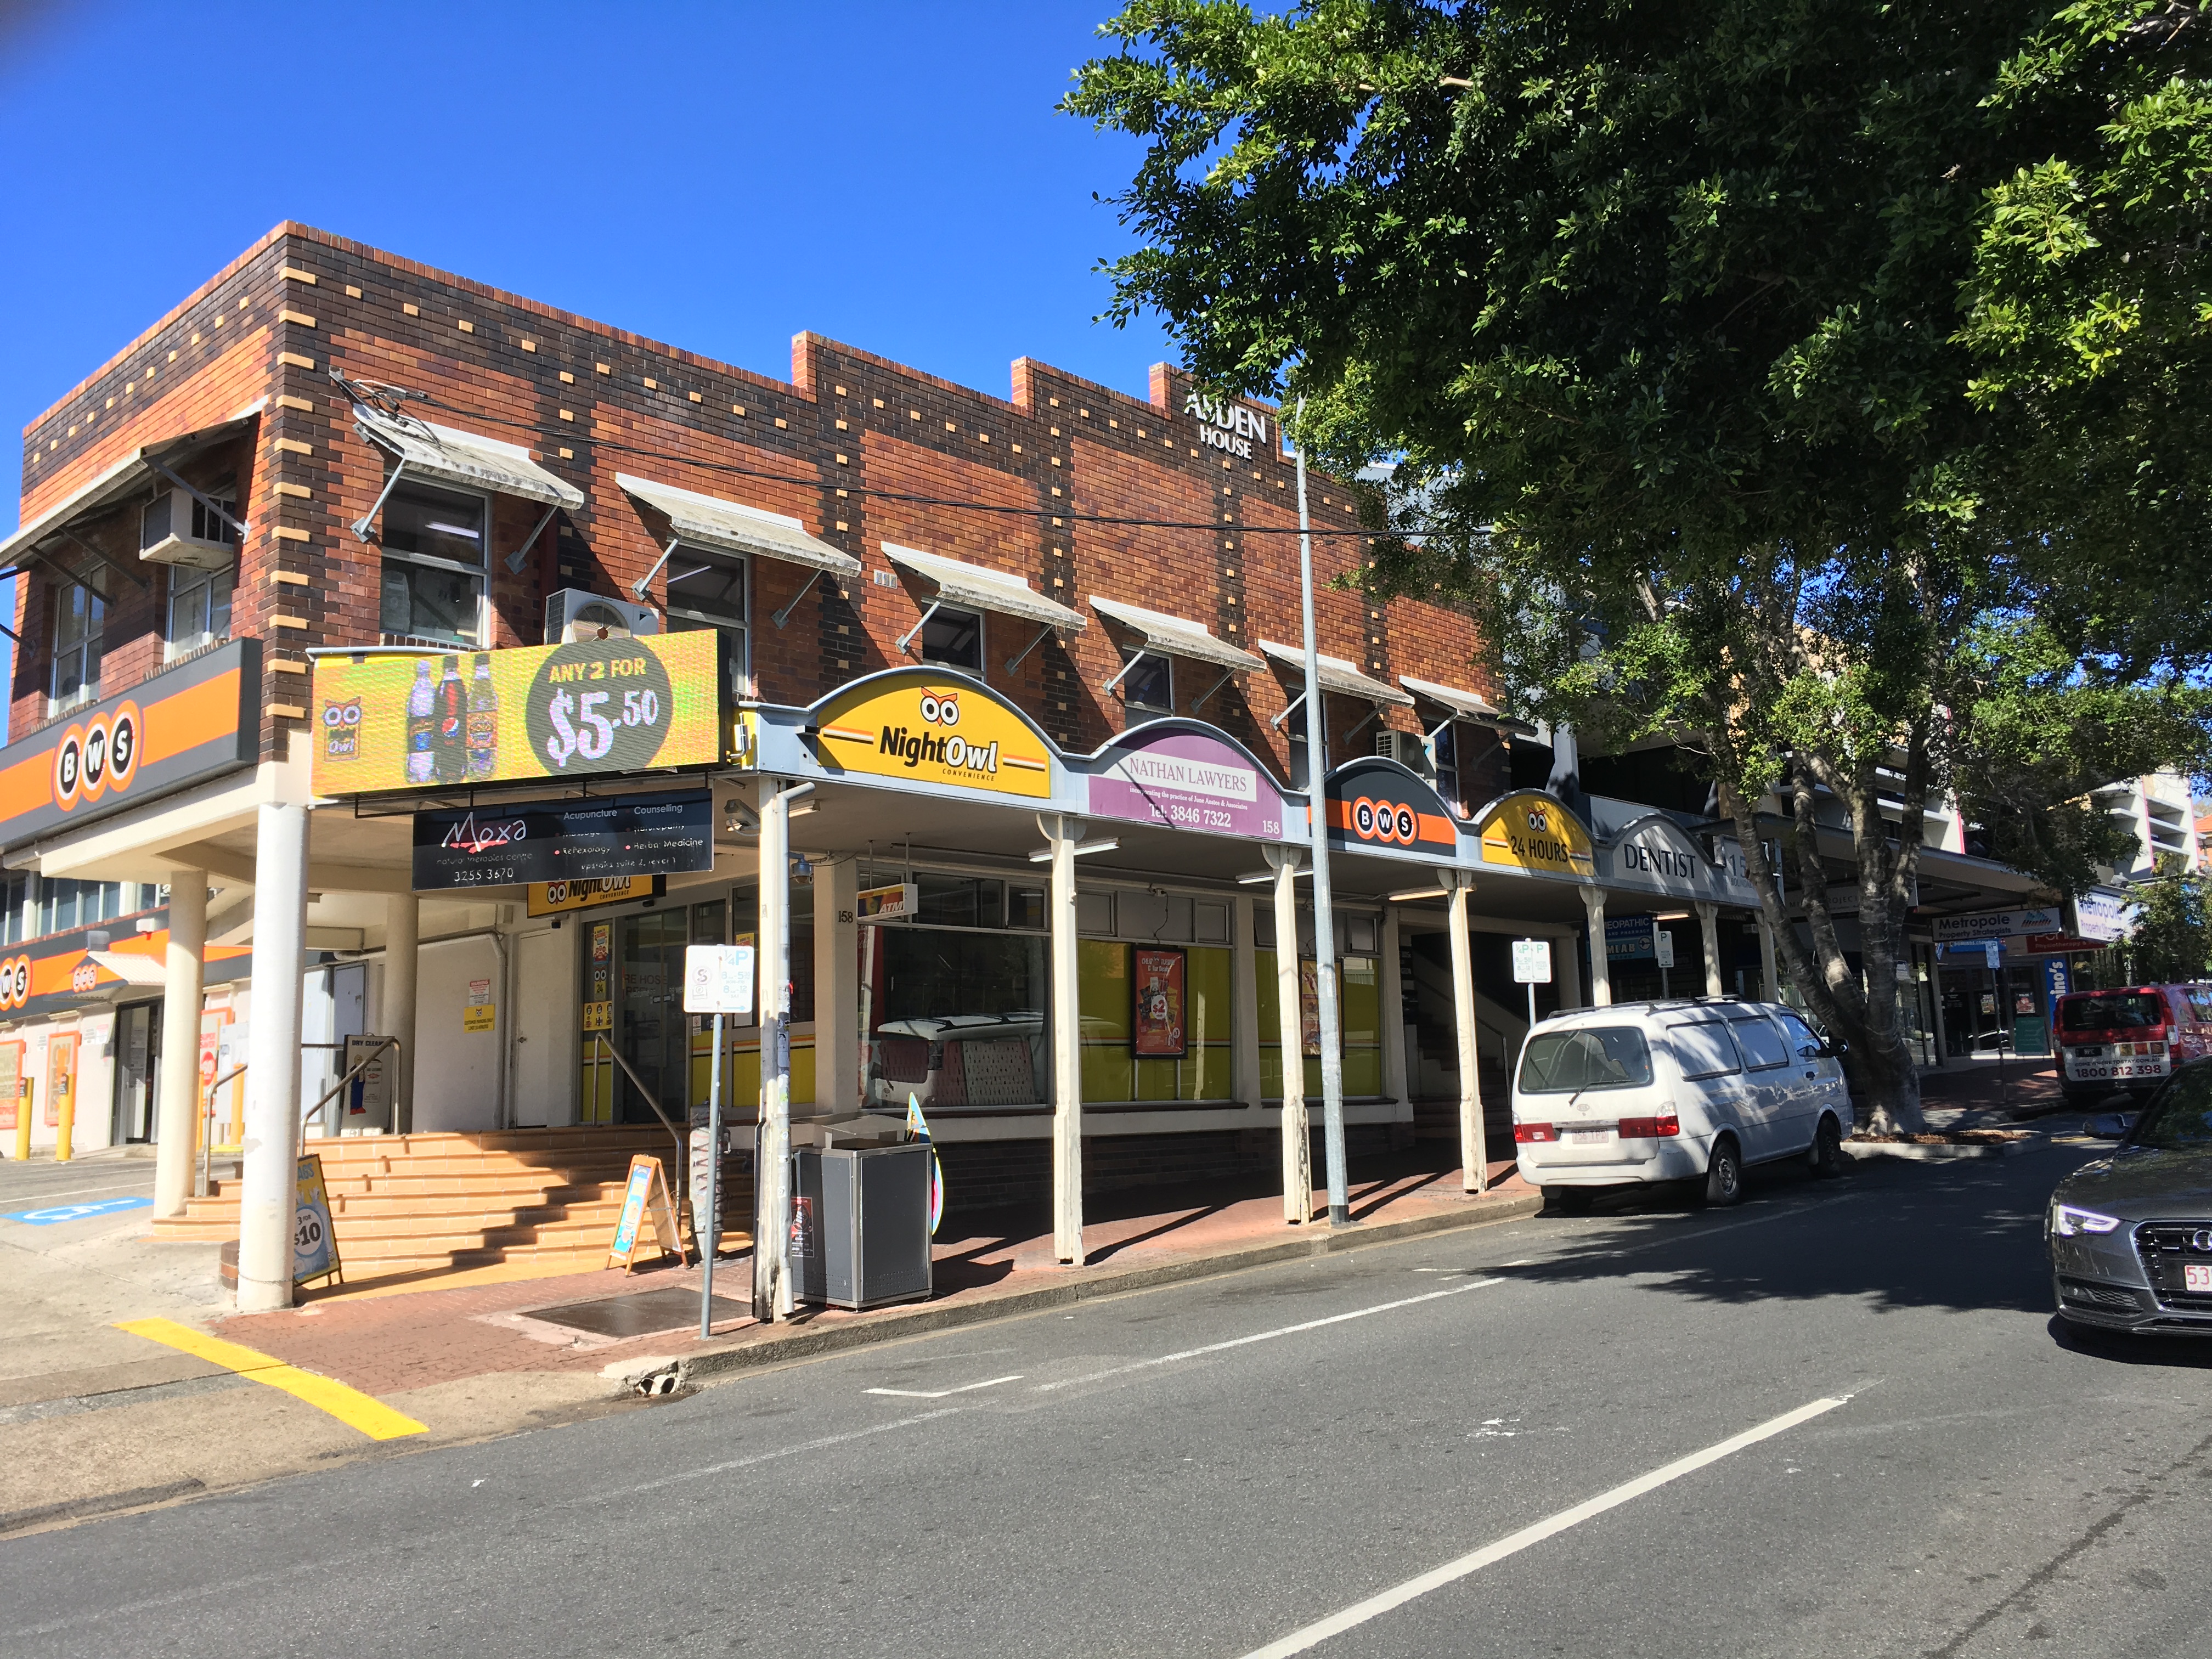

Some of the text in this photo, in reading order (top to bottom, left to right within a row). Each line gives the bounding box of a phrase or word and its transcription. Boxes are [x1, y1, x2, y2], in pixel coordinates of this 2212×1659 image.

[1200, 424, 1251, 460] HOUSE
[549, 658, 646, 683] ANY 2 FOR
[547, 687, 659, 766] $5.50
[64, 730, 128, 783] BWS
[879, 726, 998, 774] NightOwl
[943, 768, 995, 781] CONVENIENCE
[1130, 758, 1246, 792] NATHAN LAWYERS
[1170, 792, 1187, 801] practice
[1226, 800, 1248, 810] Associates
[563, 809, 618, 820] Acupuncture
[634, 804, 683, 815] Counselling
[1149, 803, 1231, 827] Tel: 3846 7322
[1263, 820, 1280, 834] 158
[1361, 810, 1408, 832] BWS
[441, 811, 527, 851] Moxa
[664, 838, 703, 848] Medicine
[1510, 836, 1568, 863] 24 HOURS
[1624, 843, 1697, 879] DENTIST
[454, 868, 514, 882] 3255 3670
[600, 890, 629, 900] CONVENIENCE
[879, 901, 904, 914] ATM
[838, 911, 853, 923] 158
[1939, 913, 2010, 930] Metropole
[1939, 927, 2011, 939] Property Strategists
[2081, 919, 2101, 934] Property
[1661, 933, 1667, 941] P
[1537, 944, 1544, 953] P
[2035, 941, 2080, 949] Physiotherapy
[640, 975, 668, 985] HOSE
[1153, 1000, 1165, 1013] $2
[2075, 1064, 2162, 1078] 1800 812 398
[1573, 1130, 1606, 1141] 756 TPD
[297, 1216, 302, 1226] 3
[294, 1222, 321, 1246] $10
[2186, 1267, 2210, 1285] 53
